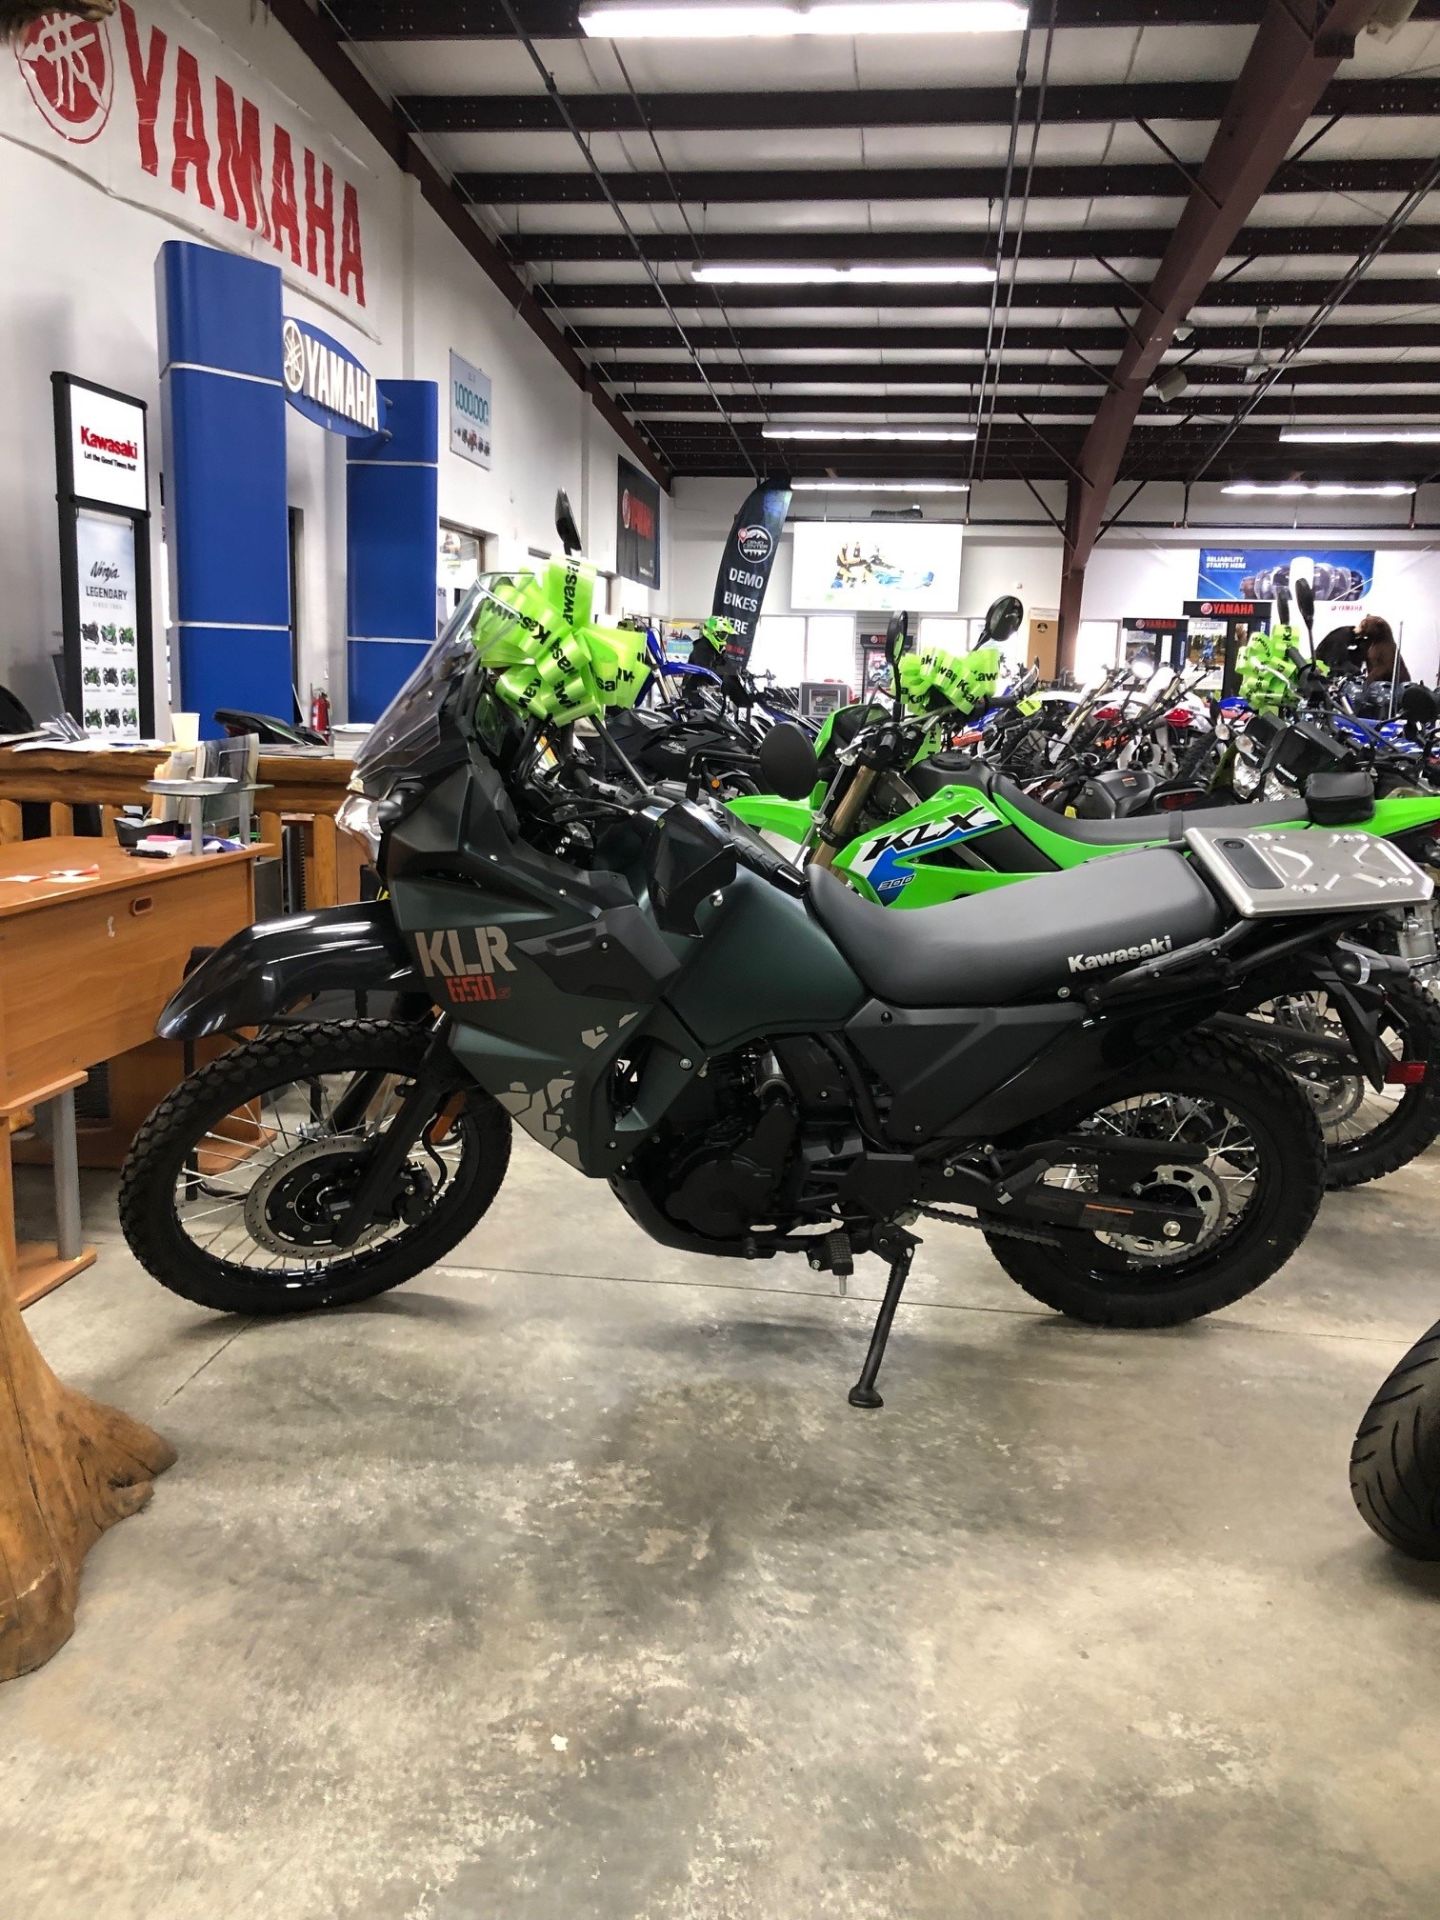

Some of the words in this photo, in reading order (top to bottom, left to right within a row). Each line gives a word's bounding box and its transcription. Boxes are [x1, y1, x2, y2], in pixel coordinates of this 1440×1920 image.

[118, 0, 366, 308] YAMAHA
[303, 333, 379, 432] YAMAHA
[81, 425, 138, 460] Kawasaki
[85, 586, 128, 601] LEGENDARY
[728, 567, 764, 590] DEMO
[723, 591, 758, 613] BIKES
[1213, 603, 1254, 615] YAMAHA
[863, 805, 985, 863] KLX
[877, 873, 916, 892] 300
[413, 925, 518, 978] KLR
[1066, 934, 1173, 974] Kawasaki
[445, 974, 497, 1003] 650
